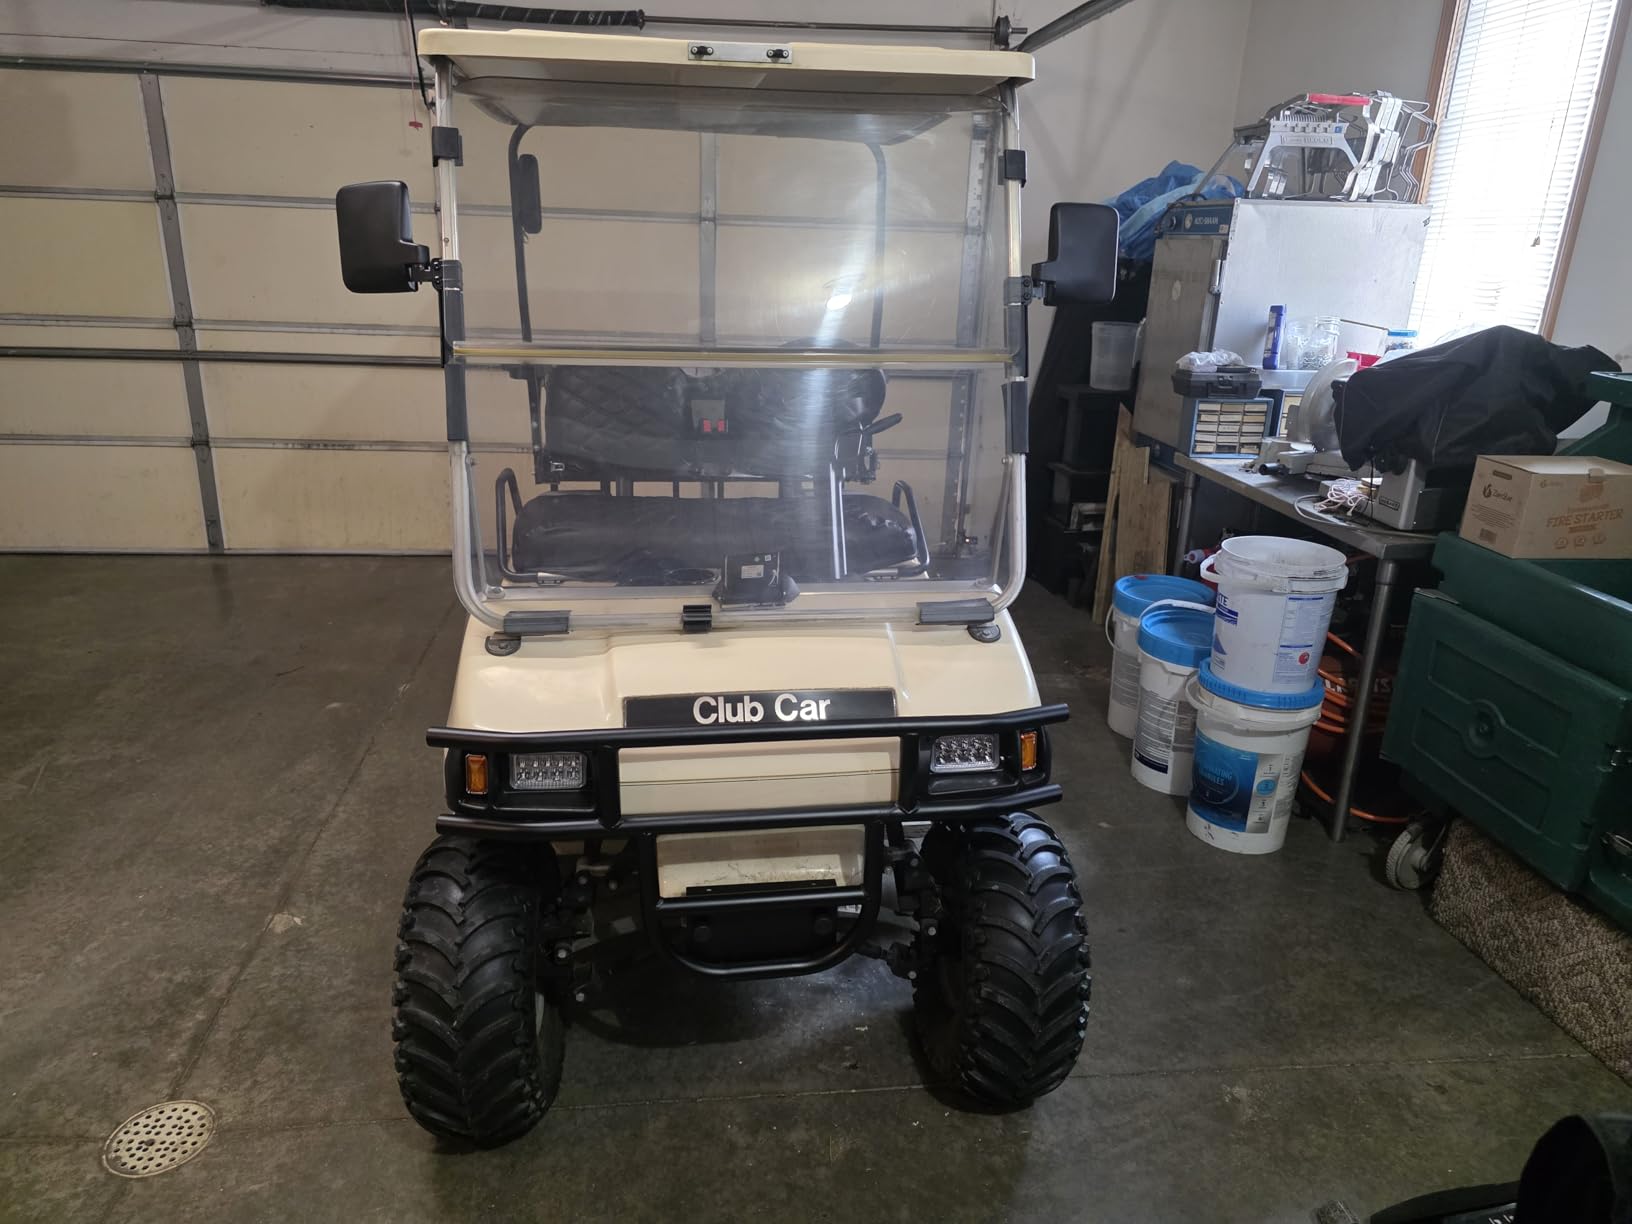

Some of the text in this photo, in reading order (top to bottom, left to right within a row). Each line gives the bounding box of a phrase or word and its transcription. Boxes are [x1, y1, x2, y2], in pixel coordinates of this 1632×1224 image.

[1545, 514, 1573, 528] FIRE
[1573, 508, 1624, 524] STARTER
[693, 693, 831, 725] Club Car
